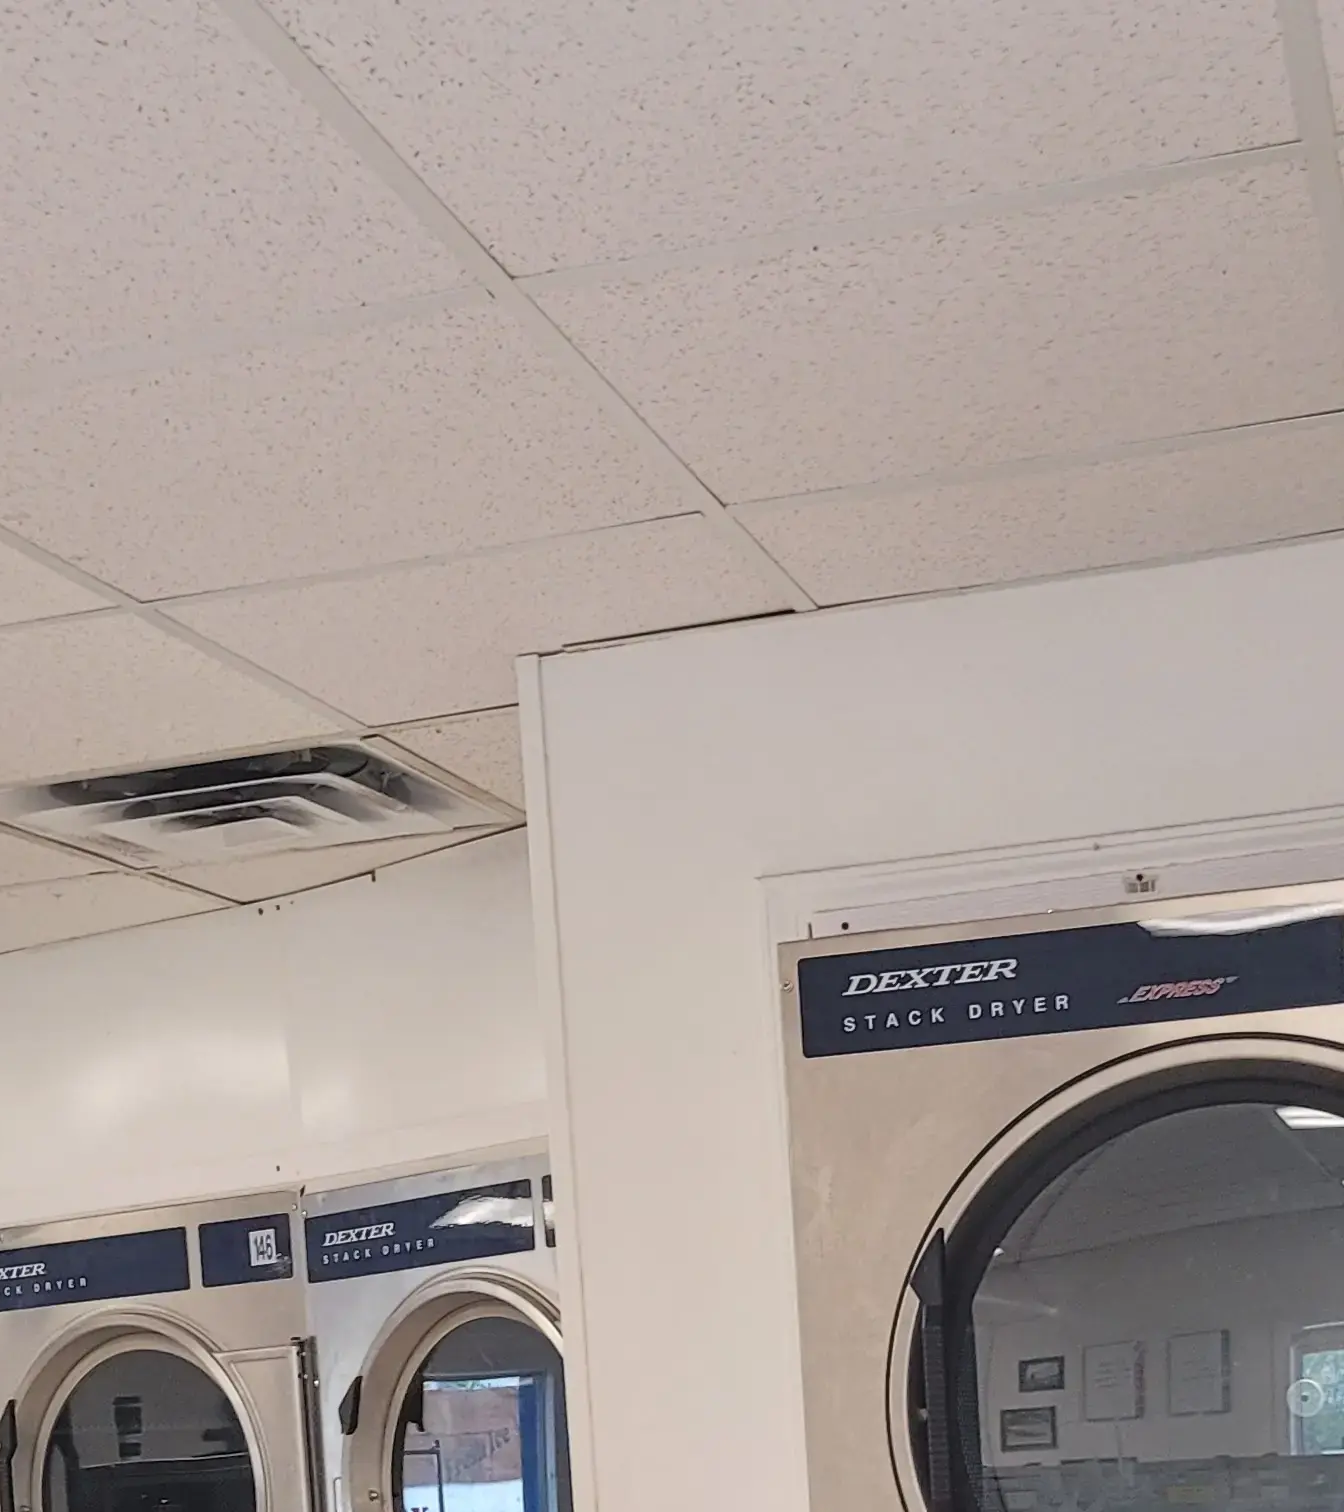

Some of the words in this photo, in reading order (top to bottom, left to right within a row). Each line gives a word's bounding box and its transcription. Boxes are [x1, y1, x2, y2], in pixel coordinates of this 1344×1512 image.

[841, 958, 1019, 997] DEXTER
[1128, 977, 1224, 1003] EXPRESS
[843, 1007, 945, 1033] STACK
[968, 994, 1071, 1020] DRYER
[322, 1222, 396, 1247] DEXTER
[323, 1249, 372, 1265] STACK
[382, 1238, 435, 1256] DRYER
[33, 1277, 88, 1293] DRYER
